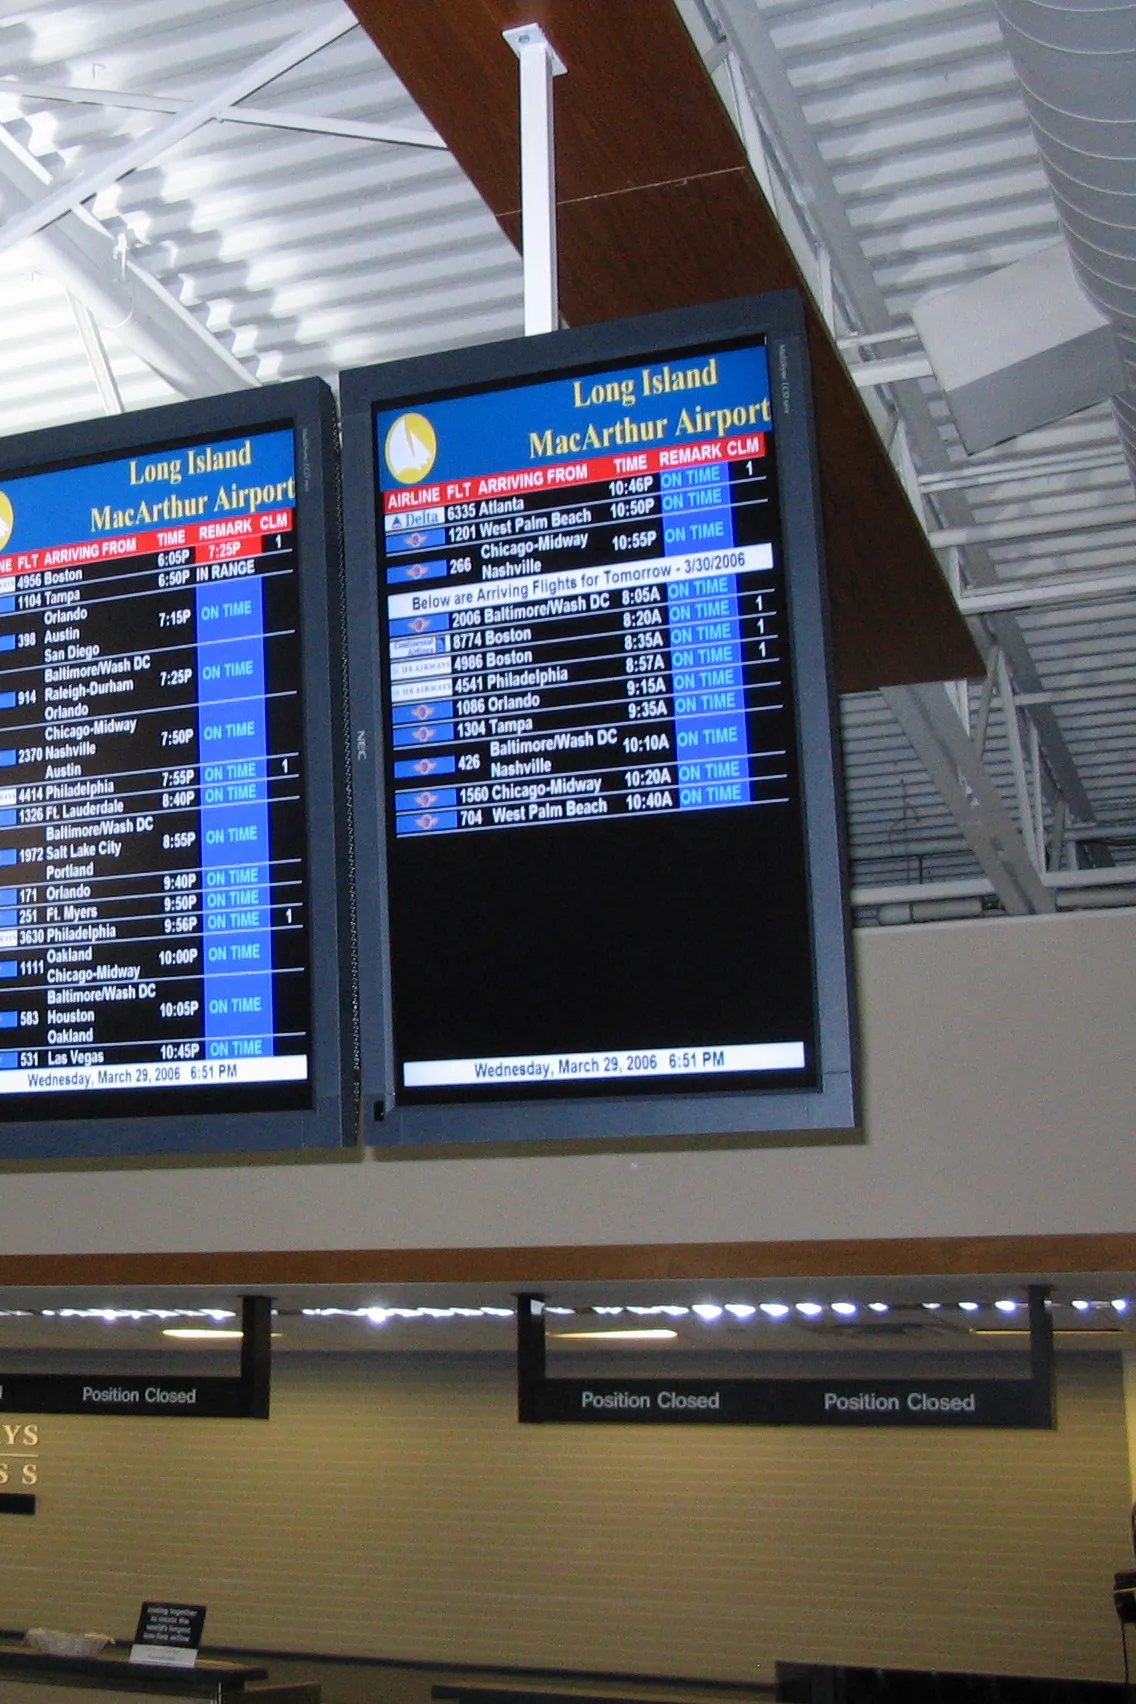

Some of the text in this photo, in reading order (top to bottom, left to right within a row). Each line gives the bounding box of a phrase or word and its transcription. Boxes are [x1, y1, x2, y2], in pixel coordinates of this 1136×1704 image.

[574, 359, 718, 408] Long Island
[529, 398, 772, 458] MacArthur Airport
[129, 440, 252, 485] Long Island
[387, 439, 759, 509] AIRLINE FLT ARRIVING FROM TIME REMARK CLM
[91, 477, 296, 532] MacArthur Airport
[404, 509, 440, 527] Delta
[448, 502, 476, 521] 6335
[478, 497, 524, 515] Atlanta
[609, 477, 653, 496] 10:46P
[662, 472, 681, 487] ON
[687, 467, 720, 483] TIME
[17, 555, 39, 569] FLT
[44, 546, 100, 565] ARRIVING
[102, 538, 137, 555] FROM
[157, 530, 186, 545] TIME
[199, 520, 253, 540] REMARK
[260, 512, 288, 528] CLM
[17, 575, 41, 589] 4956
[44, 569, 83, 585] Boston
[157, 550, 190, 566] 6:05P
[208, 542, 241, 558] 7:25P
[18, 560, 255, 609] 1104 Tampa 6:50P IN RANGE
[412, 553, 745, 612] Below are Arriving Flights for Tomorrow 3/30/2006
[453, 632, 482, 648] 8774
[485, 627, 531, 645] Boston
[622, 610, 662, 627] 8:20A
[669, 605, 688, 621] ON
[693, 600, 730, 618] TIME
[457, 669, 734, 715] 1086 Orlando 9:15A ON TIME
[357, 730, 367, 760] NEC
[19, 890, 259, 924] 251 Ft. Myers 9:50P ON TIME
[21, 1040, 262, 1067] 531 Las Vegas 10:45P ON TIME
[28, 1065, 237, 1088] Wednesday, March 29, 2006 6:51 PM
[475, 1051, 725, 1079] Wednesday, March 29, 2006 6:51 PM
[82, 1387, 196, 1403] Position Closed
[581, 1391, 720, 1408] Position Closed
[824, 1393, 975, 1411] Position Closed
